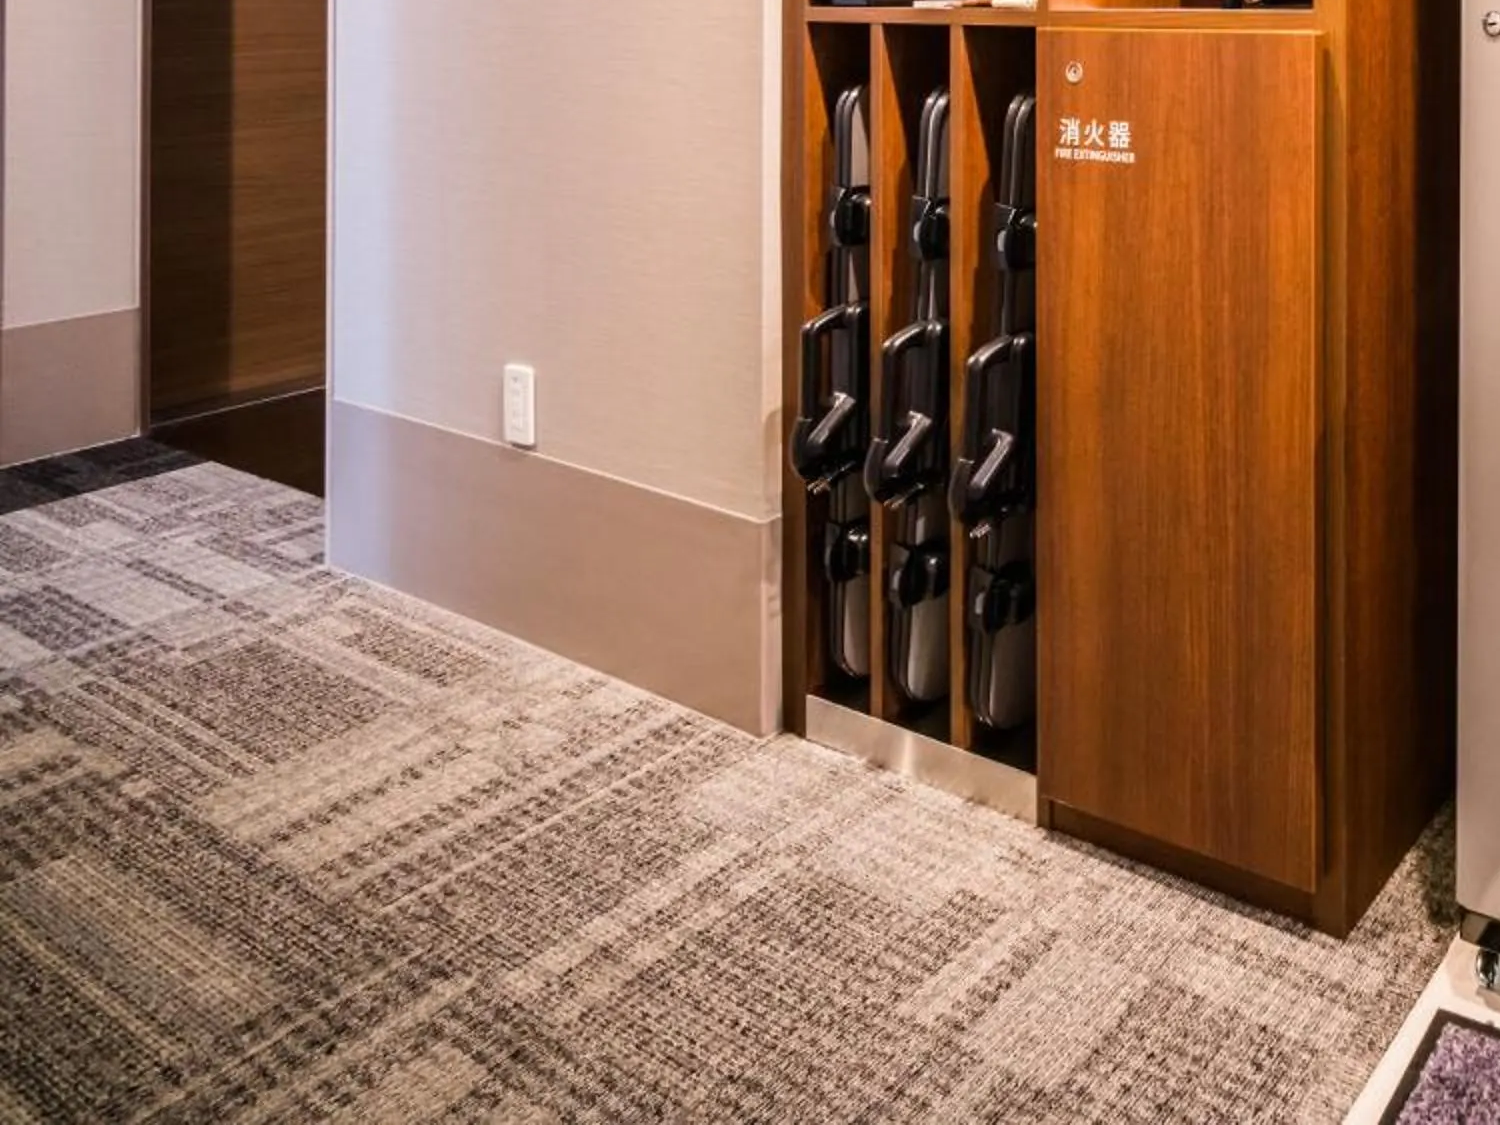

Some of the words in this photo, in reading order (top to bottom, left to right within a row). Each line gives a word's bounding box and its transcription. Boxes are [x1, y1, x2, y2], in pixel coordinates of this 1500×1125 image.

[1058, 116, 1132, 150] 消火器
[1054, 146, 1073, 160] FIRE
